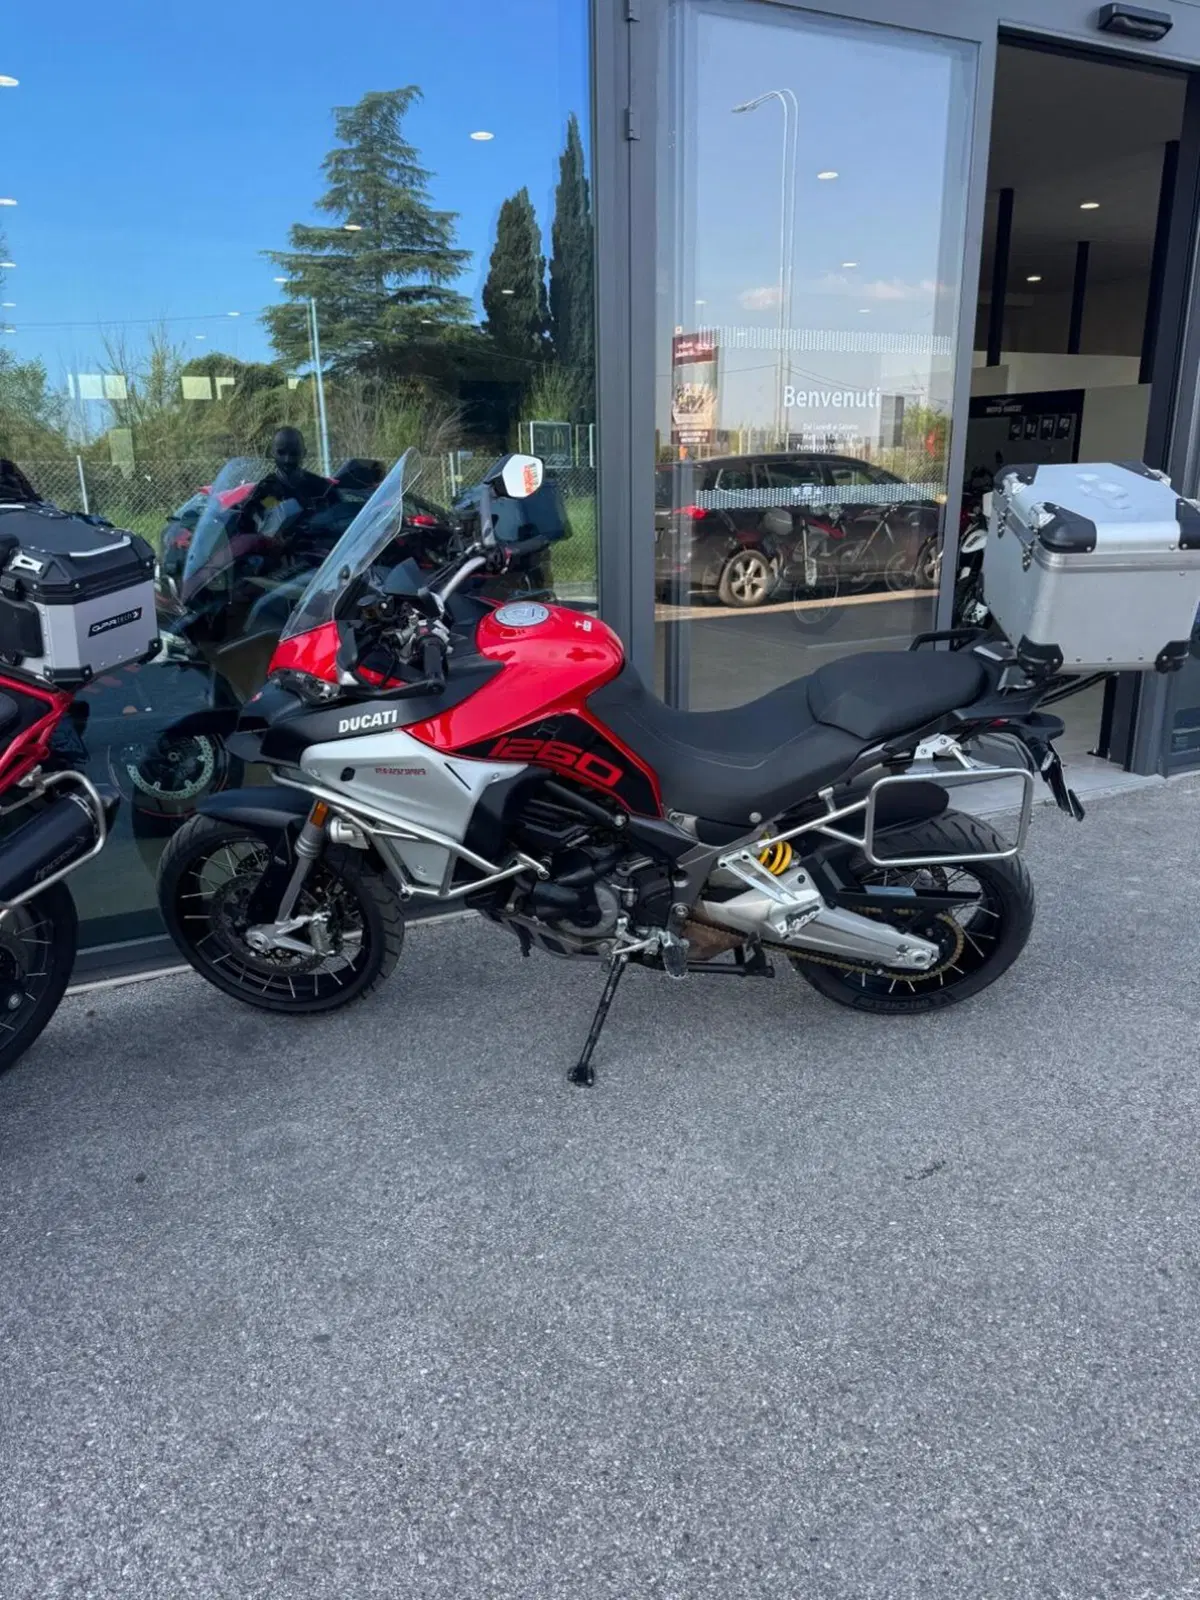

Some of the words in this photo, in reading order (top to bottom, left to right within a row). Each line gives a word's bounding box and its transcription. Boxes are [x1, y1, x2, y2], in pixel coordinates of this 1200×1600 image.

[784, 385, 881, 408] Benvenuti
[338, 710, 398, 733] DUCATI
[488, 737, 623, 786] 1260
